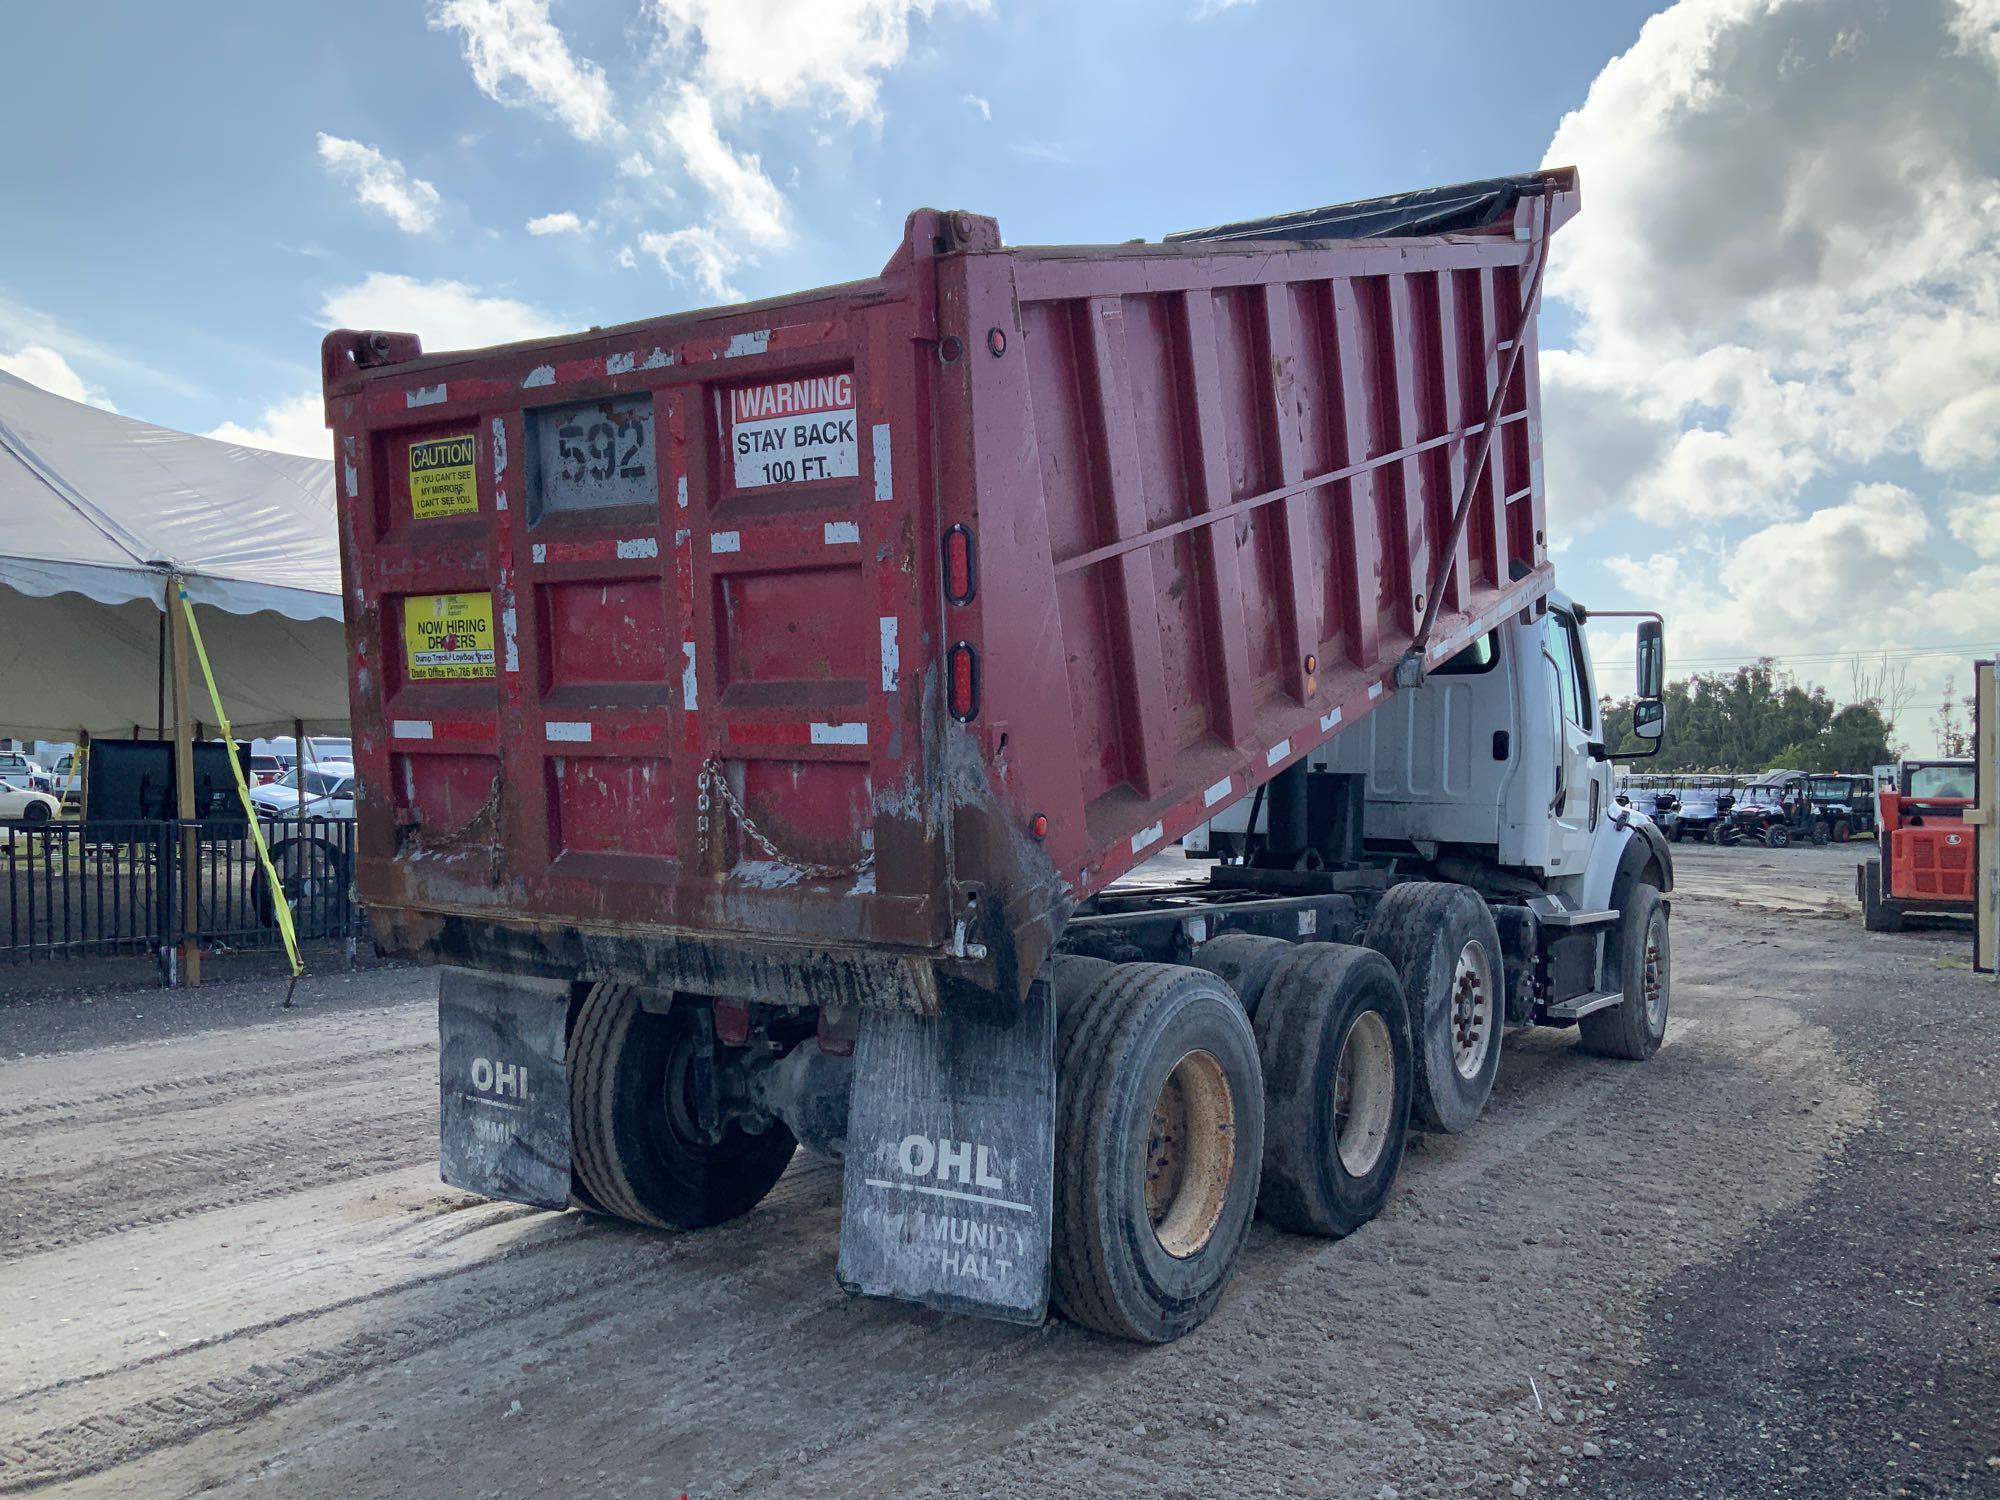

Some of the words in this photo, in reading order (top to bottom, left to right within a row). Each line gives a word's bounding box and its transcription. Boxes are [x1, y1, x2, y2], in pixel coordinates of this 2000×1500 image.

[738, 374, 851, 418] WARNING
[737, 427, 787, 455] STAY
[794, 419, 854, 448] BACK
[412, 442, 472, 469] CAUTION
[559, 420, 646, 482] 592
[413, 476, 420, 485] IF
[421, 474, 434, 484] YOU
[435, 472, 456, 482] CAN'T
[457, 470, 471, 480] SEE
[762, 460, 795, 484] 100
[802, 456, 831, 480] FT.
[420, 486, 430, 496] MY
[420, 497, 440, 508] CAN'T
[441, 496, 455, 506] SEE
[417, 620, 443, 635] NOW
[446, 618, 486, 634] HIRING
[428, 634, 477, 650] DRERS
[415, 654, 432, 663] Dump
[411, 668, 427, 678] Dade
[428, 667, 446, 678] Office
[899, 1134, 1003, 1190] OHL
